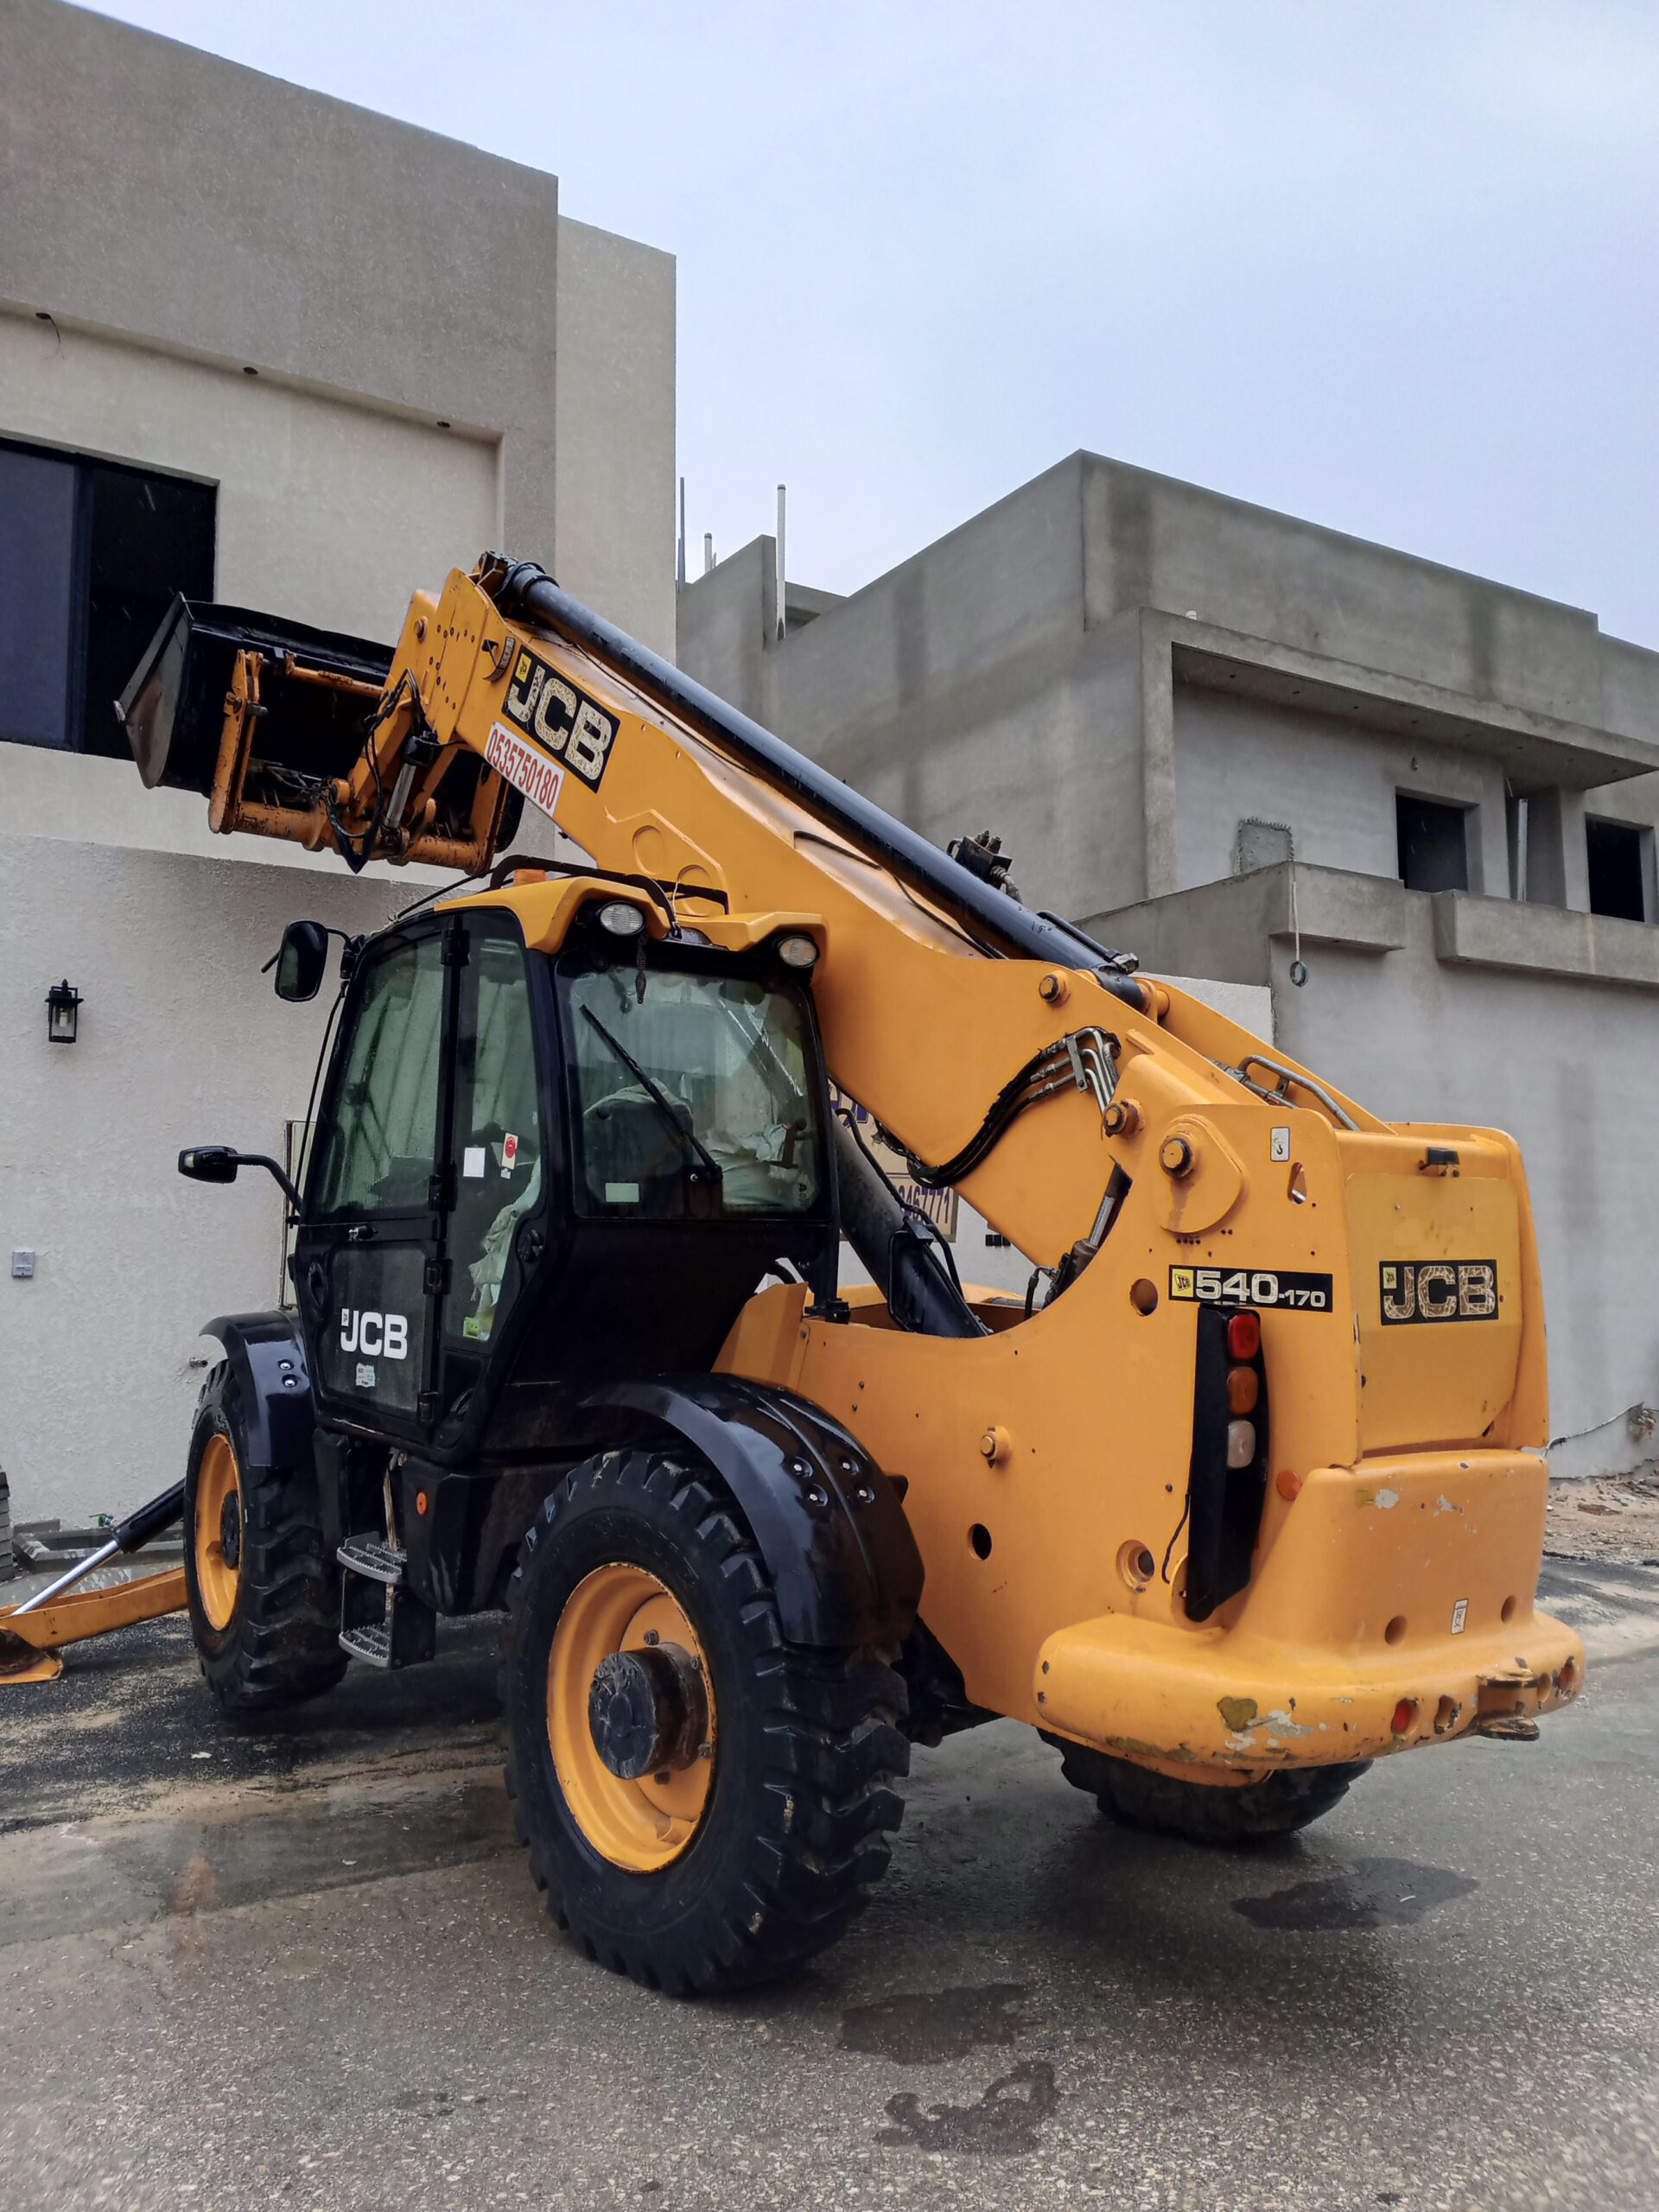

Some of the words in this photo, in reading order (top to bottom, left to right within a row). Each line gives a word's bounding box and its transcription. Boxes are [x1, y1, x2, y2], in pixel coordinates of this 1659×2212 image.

[508, 664, 613, 780] JCB
[486, 728, 559, 810] 0535750180
[1383, 1265, 1496, 1319] JCB
[340, 1310, 408, 1360] JCB
